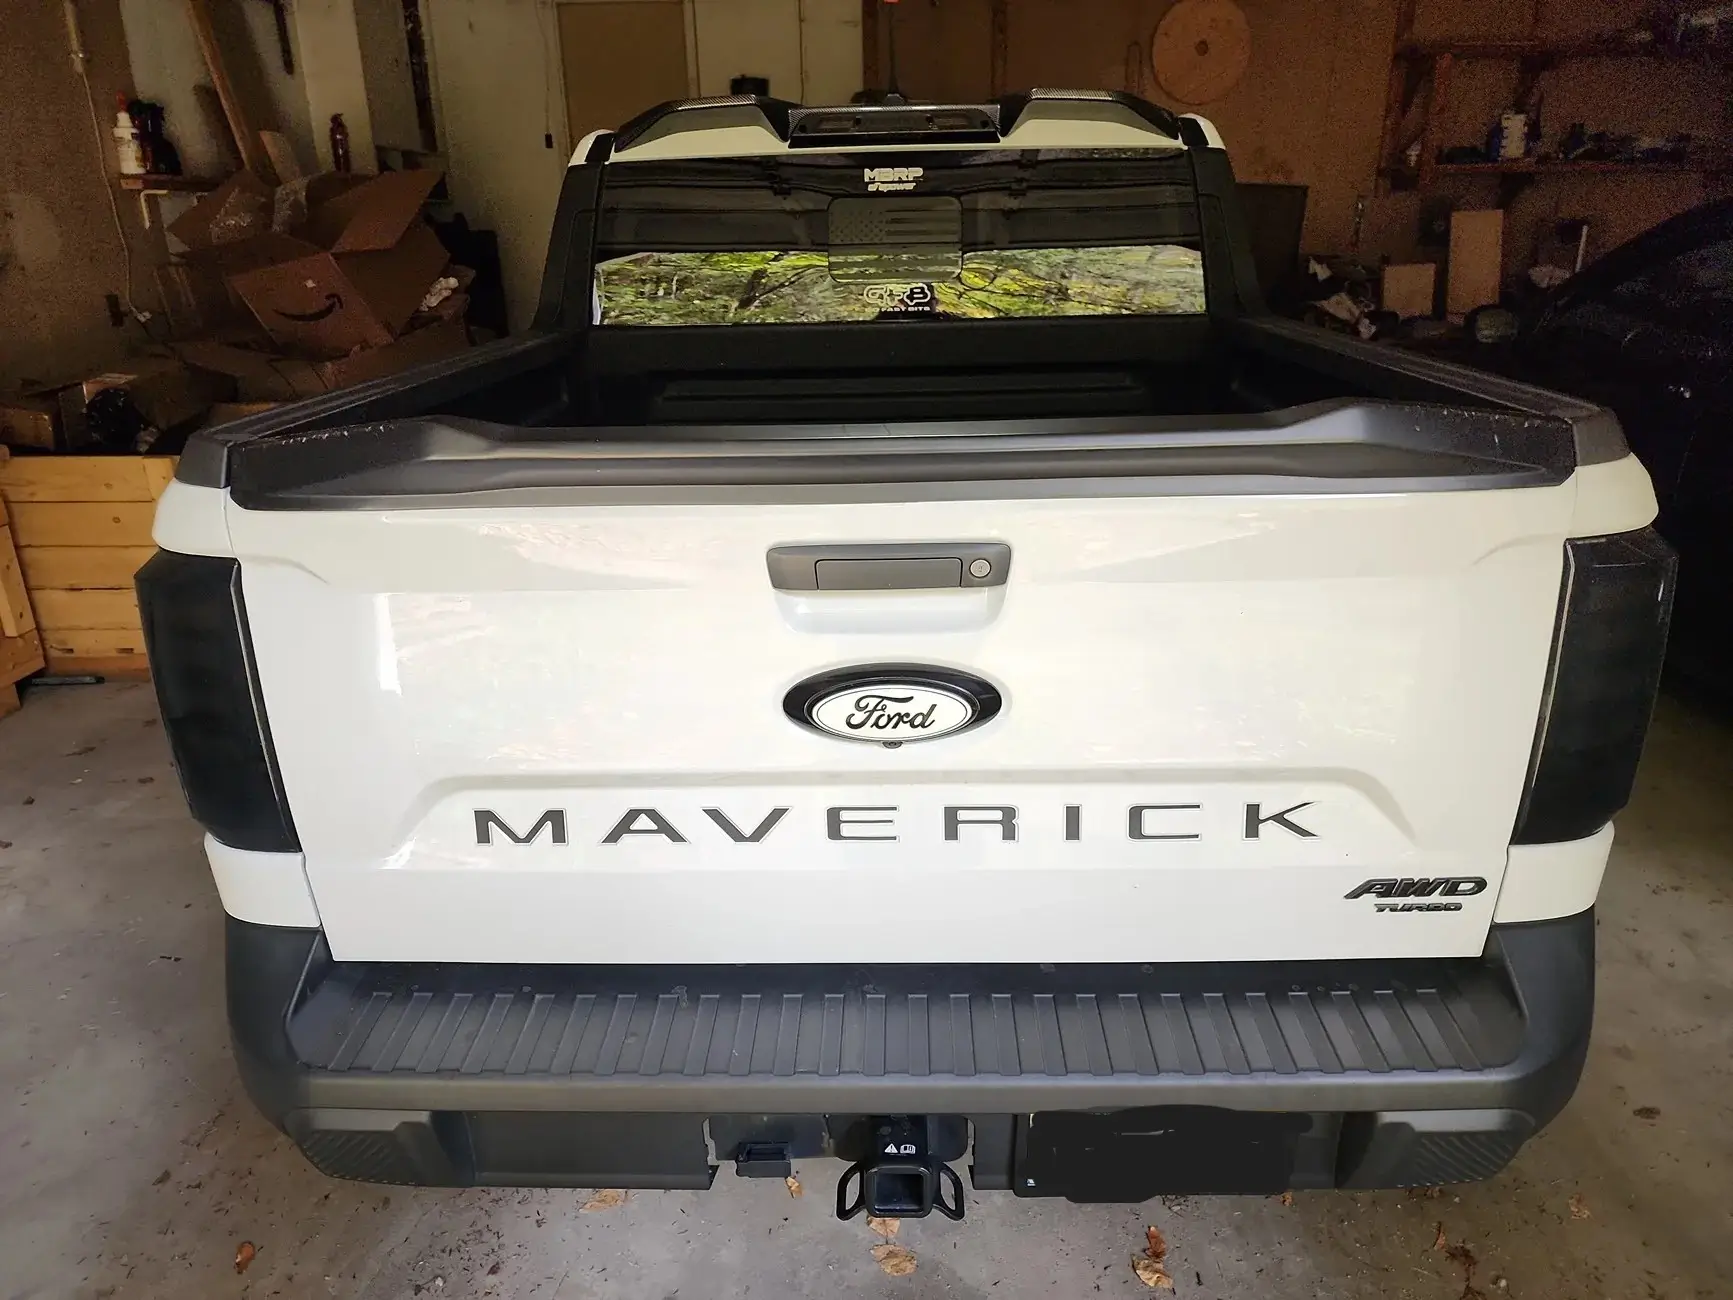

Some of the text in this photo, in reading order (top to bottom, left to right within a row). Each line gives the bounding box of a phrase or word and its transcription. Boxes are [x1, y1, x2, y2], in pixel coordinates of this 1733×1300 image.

[864, 167, 924, 182] MBRP
[845, 694, 938, 730] Ford
[473, 800, 1321, 846] MAVERICK
[1344, 876, 1488, 899] AWD
[1374, 902, 1463, 913] TURBO
